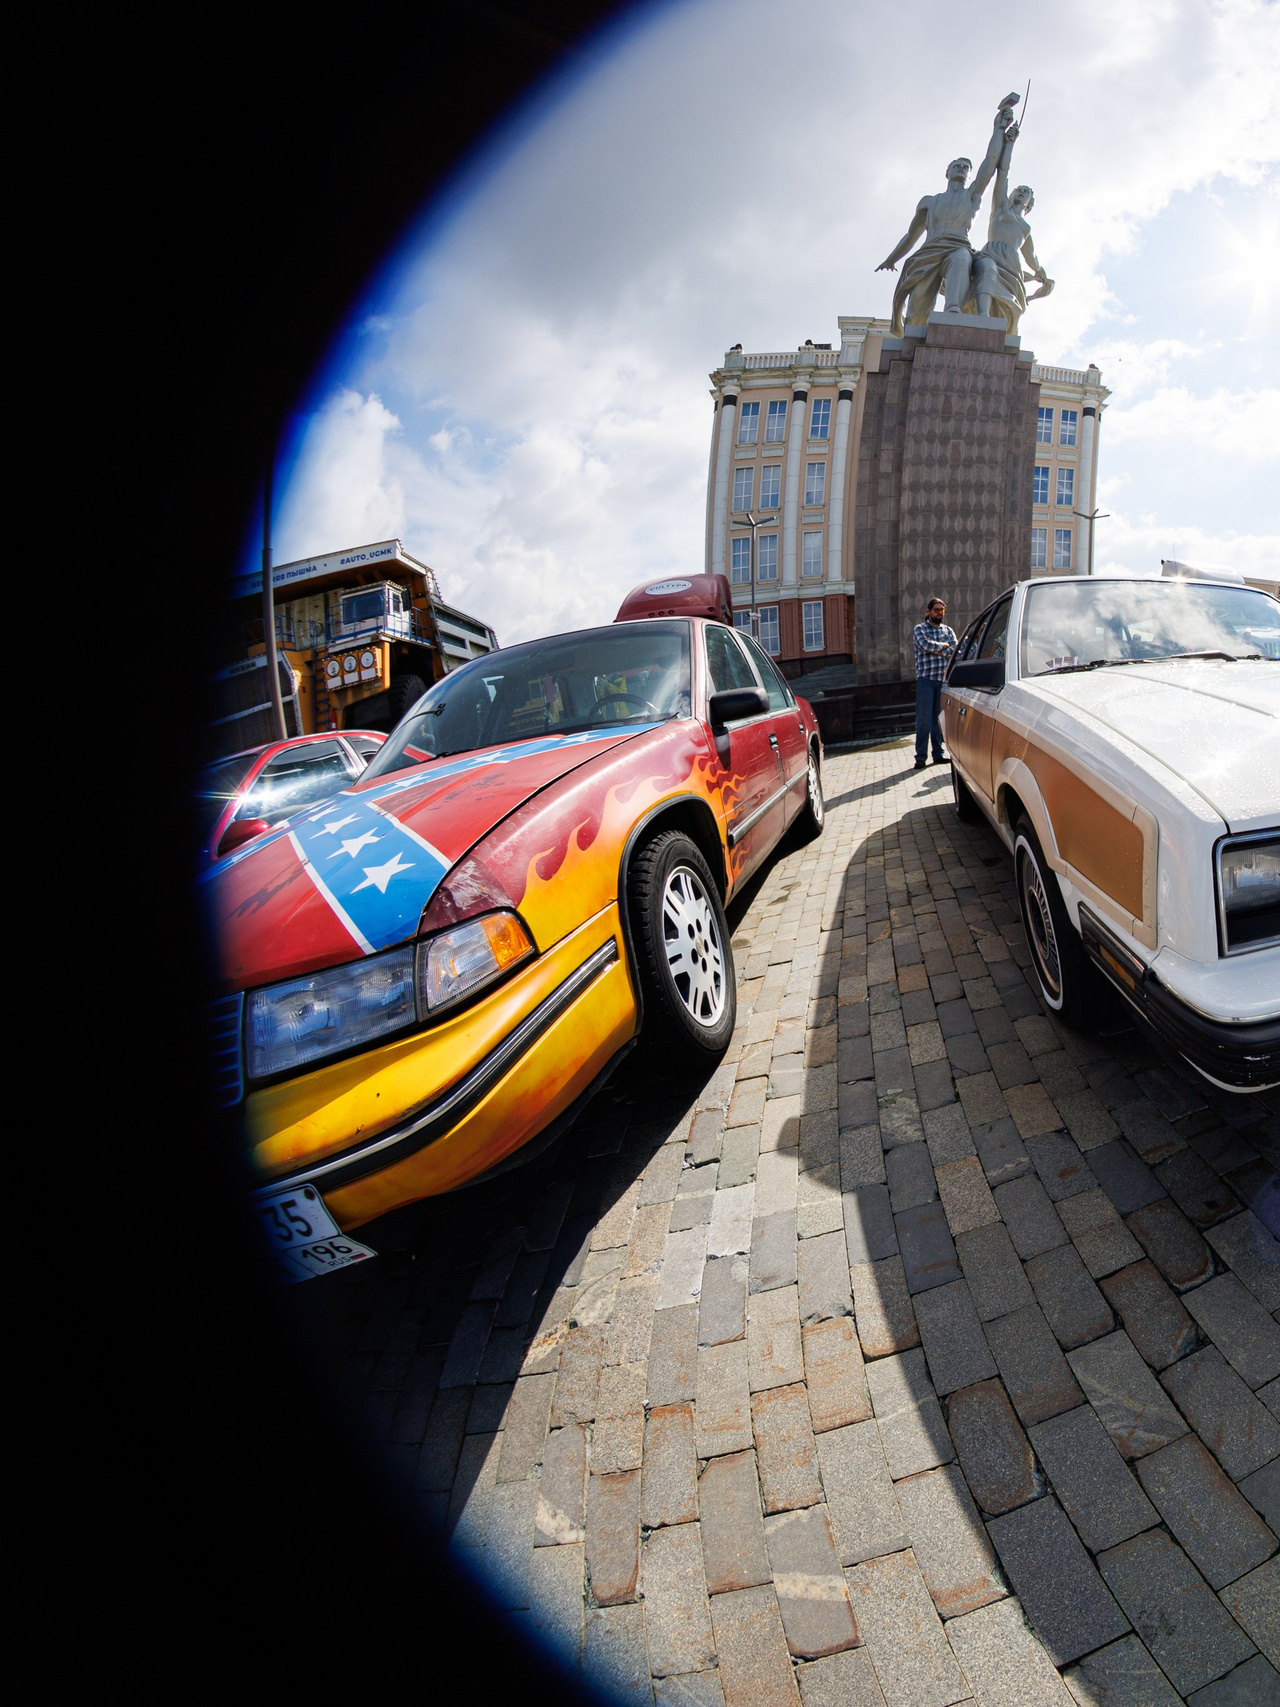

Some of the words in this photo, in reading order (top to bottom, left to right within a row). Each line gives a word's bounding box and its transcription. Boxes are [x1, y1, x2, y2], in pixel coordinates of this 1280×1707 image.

[340, 548, 392, 565] #AUTO_UGMK
[252, 573, 285, 588] ВЕНЯЯ
[286, 565, 317, 578] ПЫШМА
[302, 1241, 353, 1263] 196
[328, 1256, 351, 1268] RUS
